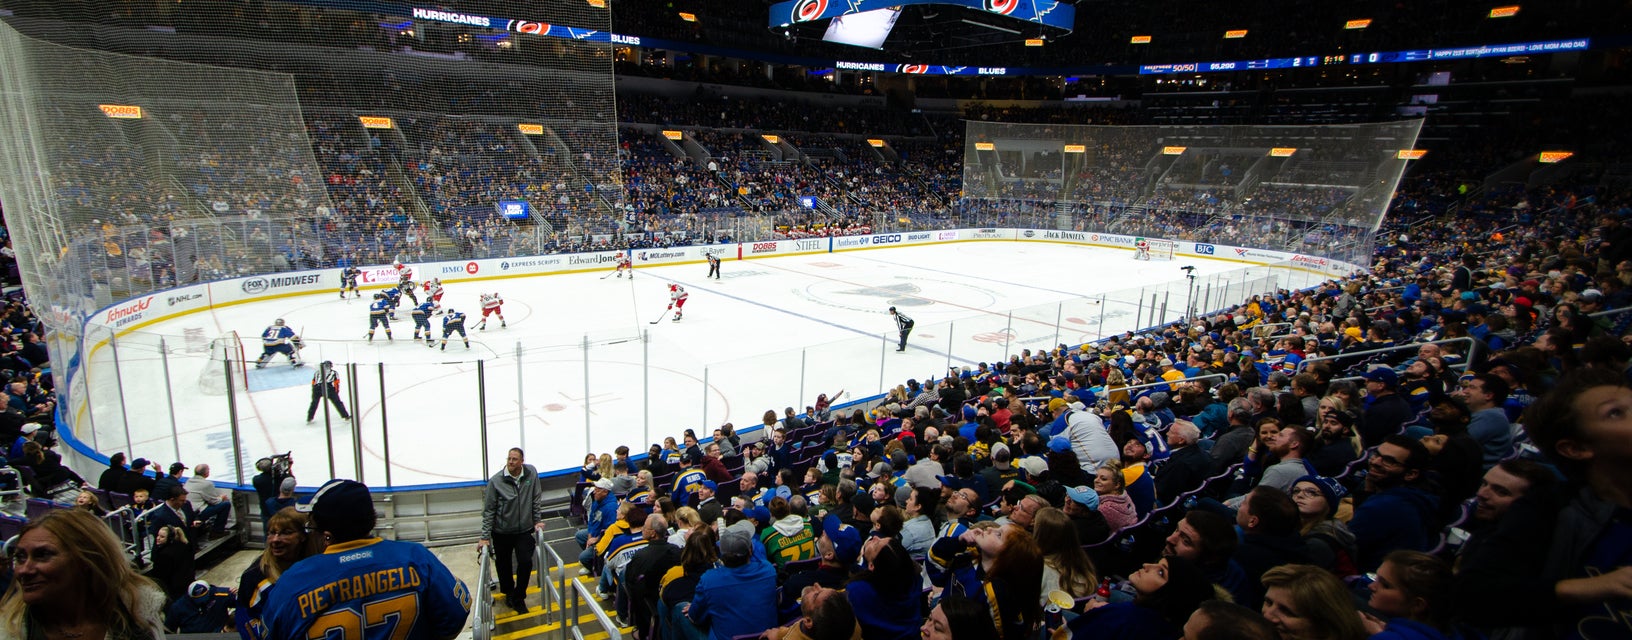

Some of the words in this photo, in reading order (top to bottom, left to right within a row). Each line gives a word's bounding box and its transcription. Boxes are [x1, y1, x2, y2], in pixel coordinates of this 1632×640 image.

[413, 8, 490, 27] HURRICANES
[611, 33, 640, 45] BLUES
[1369, 53, 1379, 62] 0
[1434, 50, 1452, 58] HAPPY
[836, 61, 885, 71] HURRICANES
[1293, 58, 1301, 67] 2
[978, 67, 1006, 75] BLUES
[1172, 64, 1194, 72] 50/50
[103, 106, 138, 115] DOBBS
[872, 234, 902, 244] GEICO
[1044, 231, 1060, 239] JACK
[1061, 232, 1085, 241] DANIEL'S
[1115, 236, 1133, 244] BANK
[753, 242, 777, 250] DOBBS
[796, 240, 821, 251] STIFEL
[838, 239, 858, 247] Anthem
[1197, 245, 1213, 254] BJC
[569, 255, 598, 265] Edward
[599, 254, 619, 263] Jone
[376, 269, 398, 277] FAMO
[247, 280, 263, 288] FOX
[270, 274, 320, 288] MIDWEST
[175, 294, 202, 303] NHL.com
[106, 296, 154, 325] Schnucks
[116, 313, 142, 328] REWARDS
[268, 329, 280, 340] 31
[780, 541, 815, 562] 77
[339, 550, 374, 564] Reebok
[297, 567, 421, 618] PIETRANGELO
